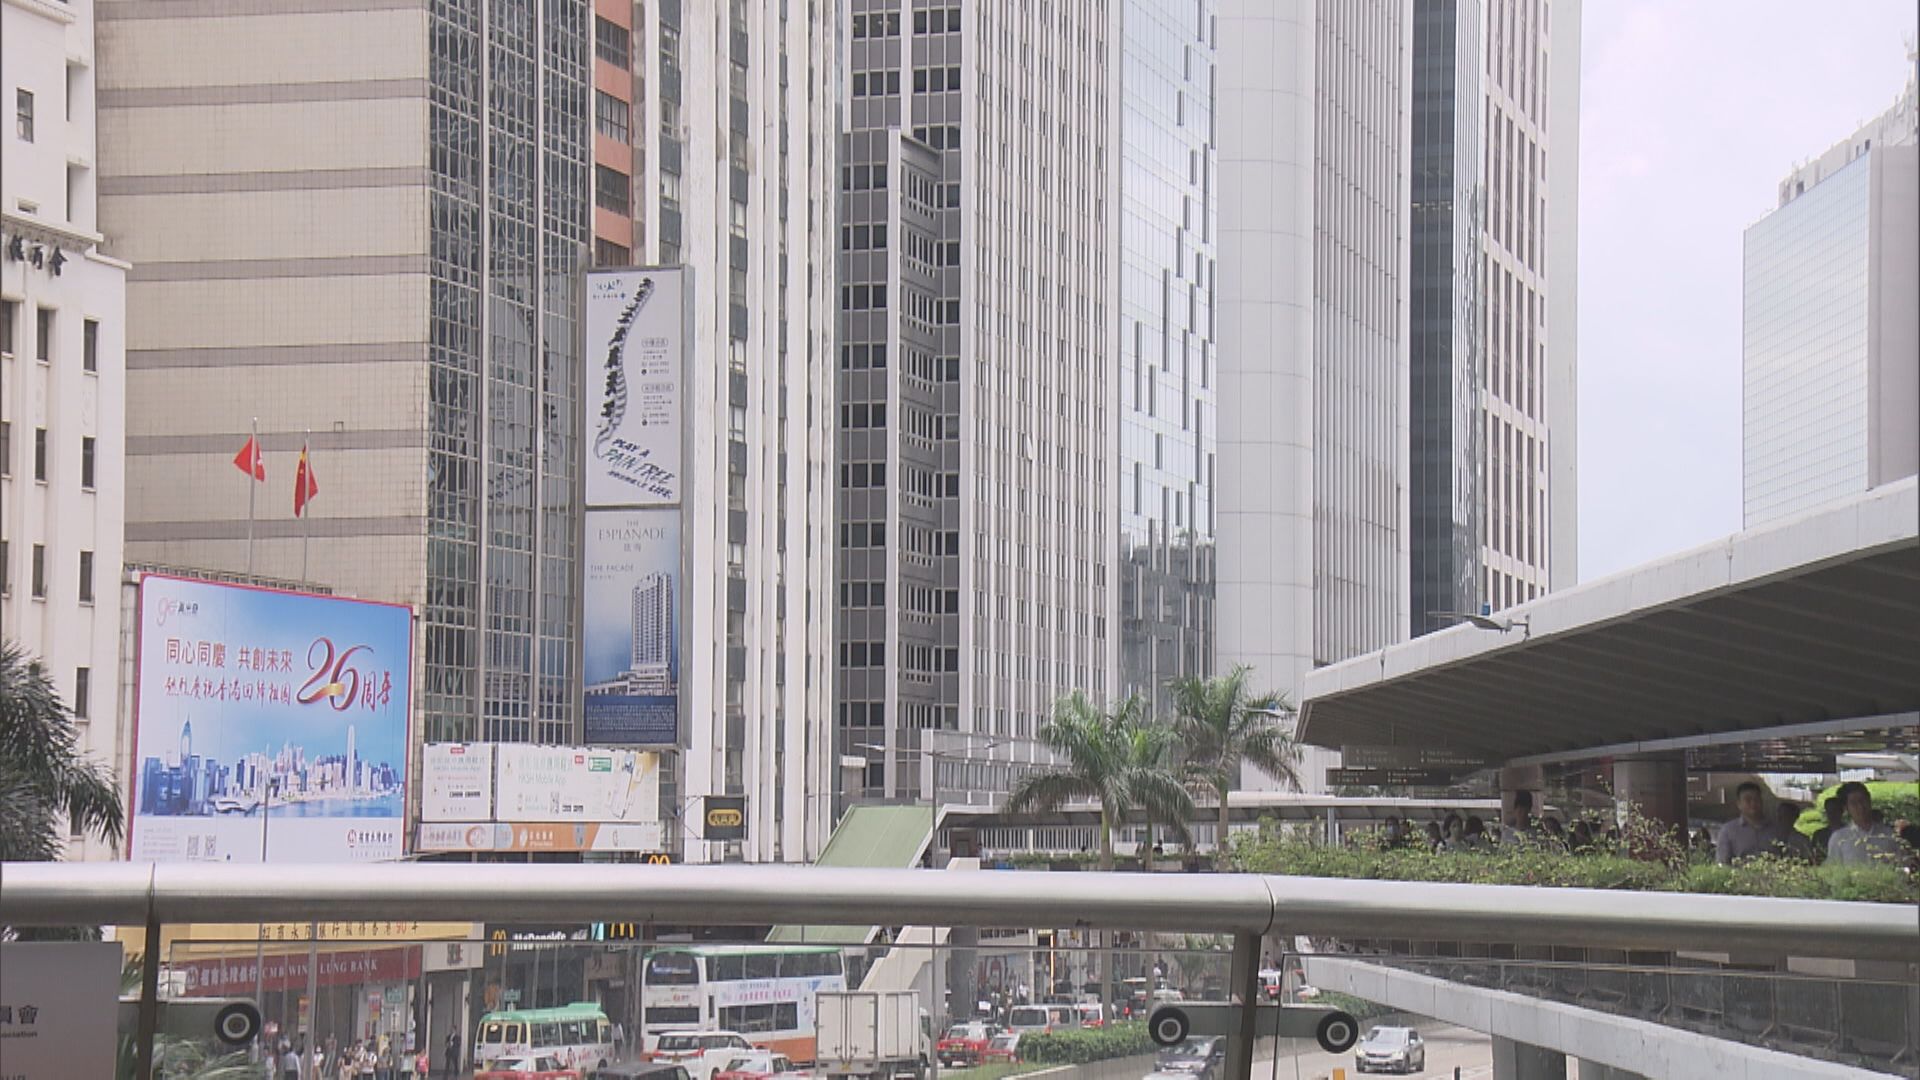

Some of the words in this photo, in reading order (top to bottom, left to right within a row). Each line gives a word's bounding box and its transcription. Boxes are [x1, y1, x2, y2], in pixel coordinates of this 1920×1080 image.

[599, 527, 665, 541] ESPLANADE
[167, 639, 225, 669] 同心同慶
[238, 645, 292, 673] 共創未來
[263, 966, 284, 978] CMB
[288, 964, 309, 977] WIN
[320, 961, 347, 974] LUNG
[350, 958, 378, 972] BANK
